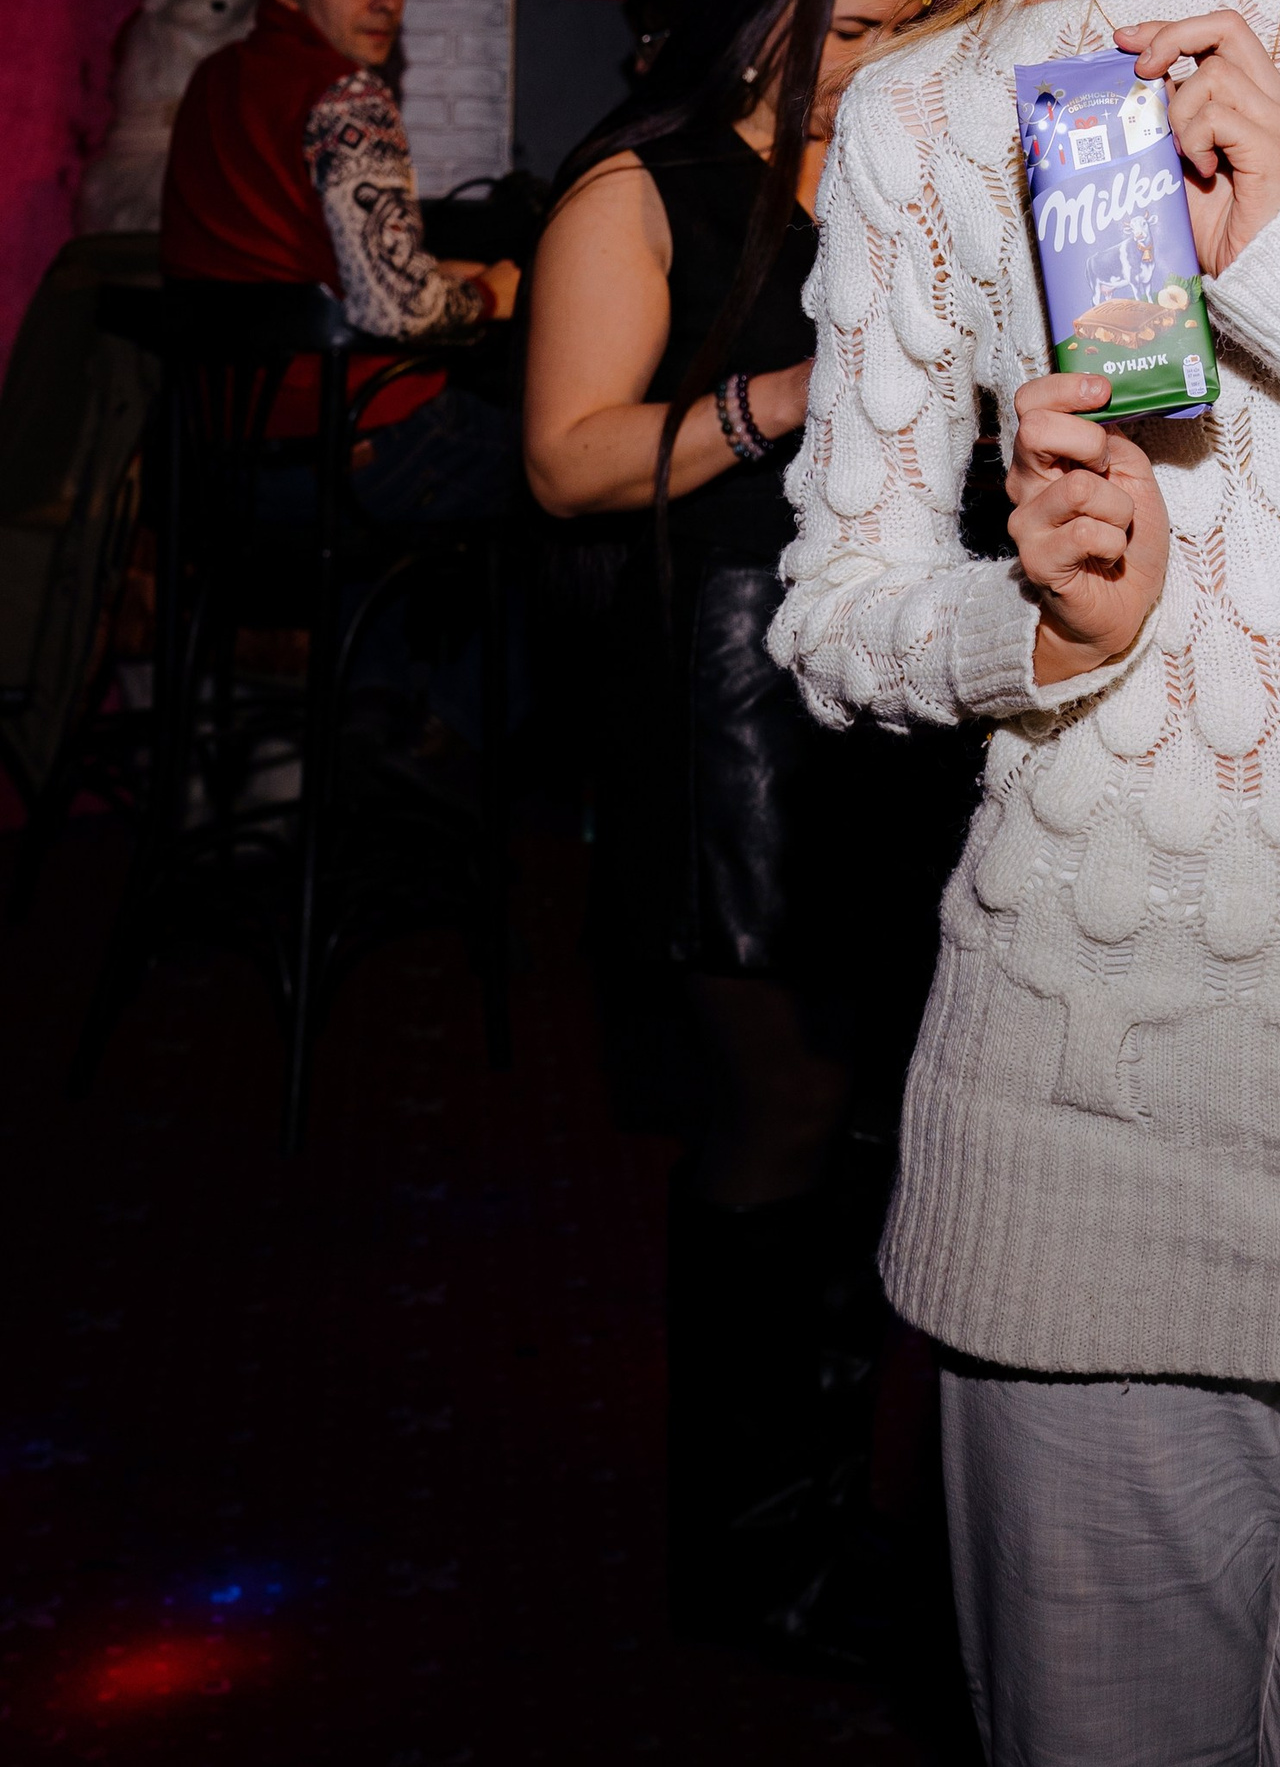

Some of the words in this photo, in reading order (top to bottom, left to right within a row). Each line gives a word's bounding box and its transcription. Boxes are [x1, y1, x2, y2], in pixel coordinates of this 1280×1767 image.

[1068, 98, 1119, 114] ОБЪЕДИНЯЕТ
[1069, 91, 1116, 106] НЕЖНОСТЬ
[1038, 163, 1181, 253] Milka
[1103, 353, 1168, 374] ФУНДУК
